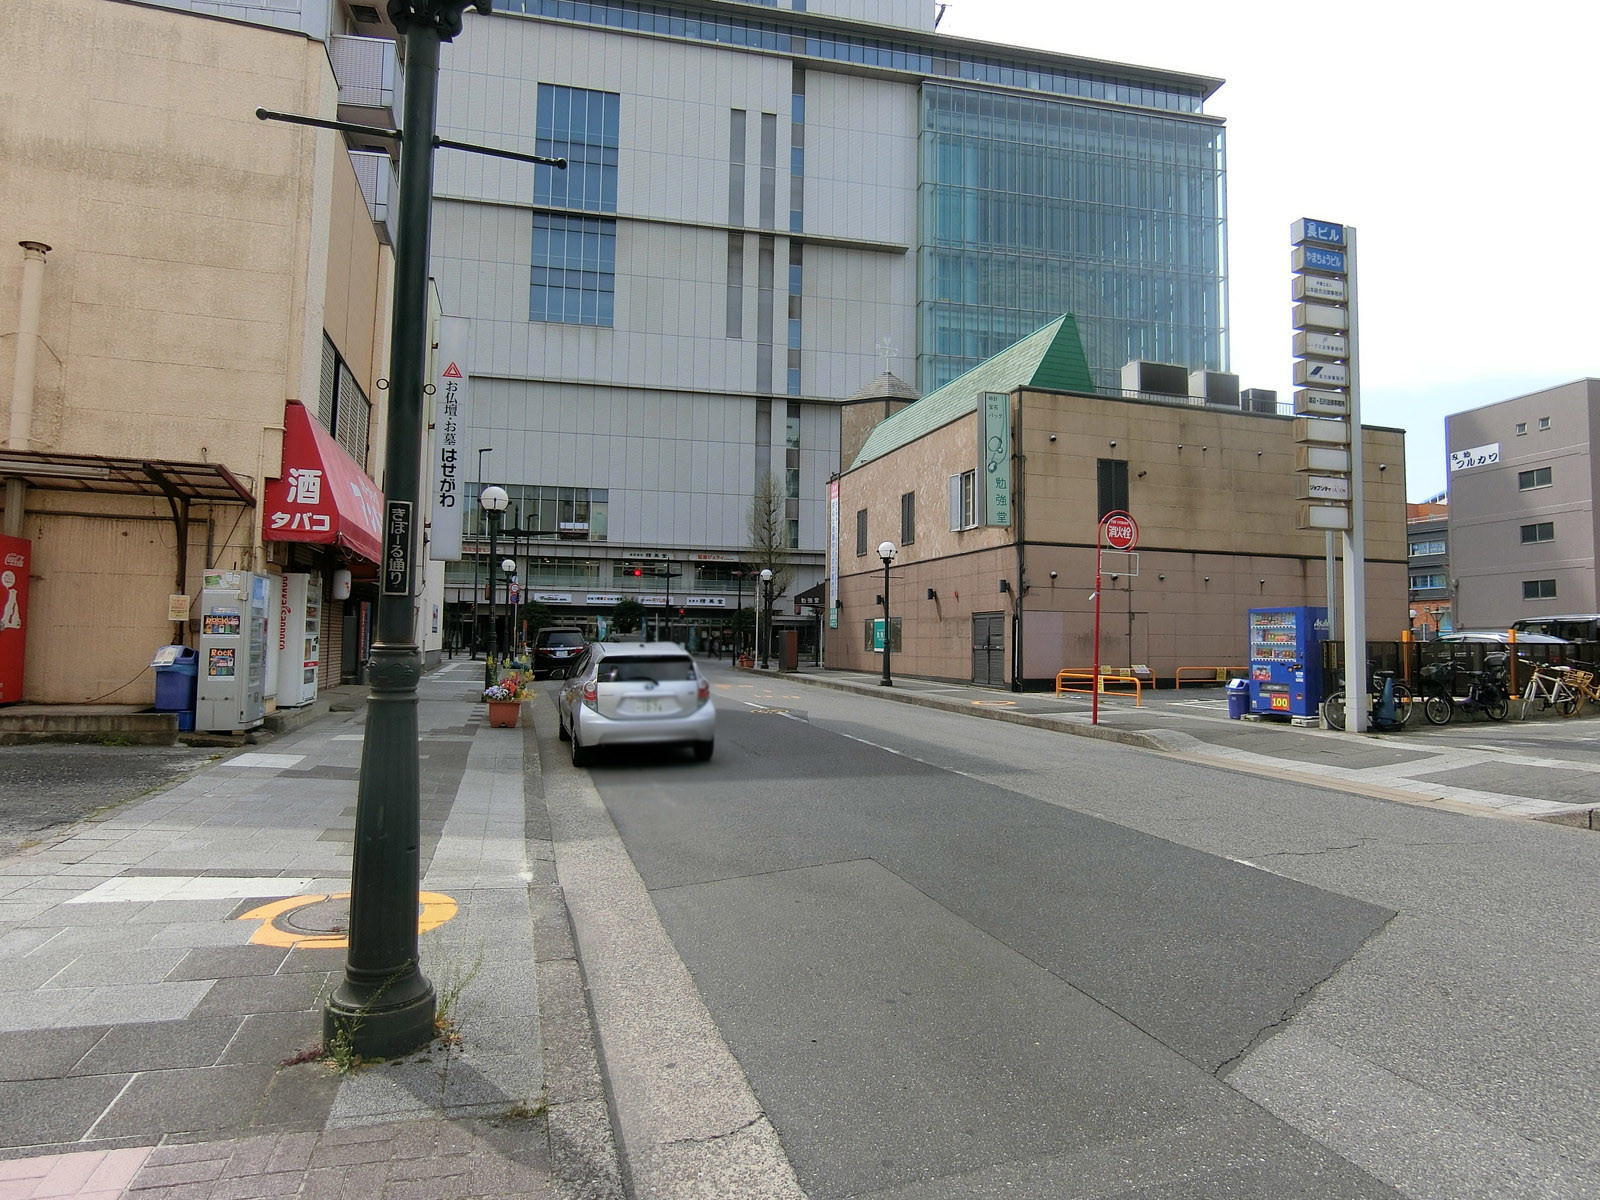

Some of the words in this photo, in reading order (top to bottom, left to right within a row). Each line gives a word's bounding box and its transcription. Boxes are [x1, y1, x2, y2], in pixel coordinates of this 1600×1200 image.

[1306, 251, 1342, 267] やまちょうビル
[445, 380, 458, 446] お仏壇・お墓
[1456, 452, 1498, 469] フルカワ
[287, 468, 323, 505] 酒
[439, 447, 457, 508] はせがわ
[995, 477, 1008, 524] 勉強堂
[271, 511, 331, 531] タバコ
[1108, 525, 1132, 539] 消火栓
[389, 508, 409, 586] きぼーる通り
[1272, 698, 1288, 707] 100
